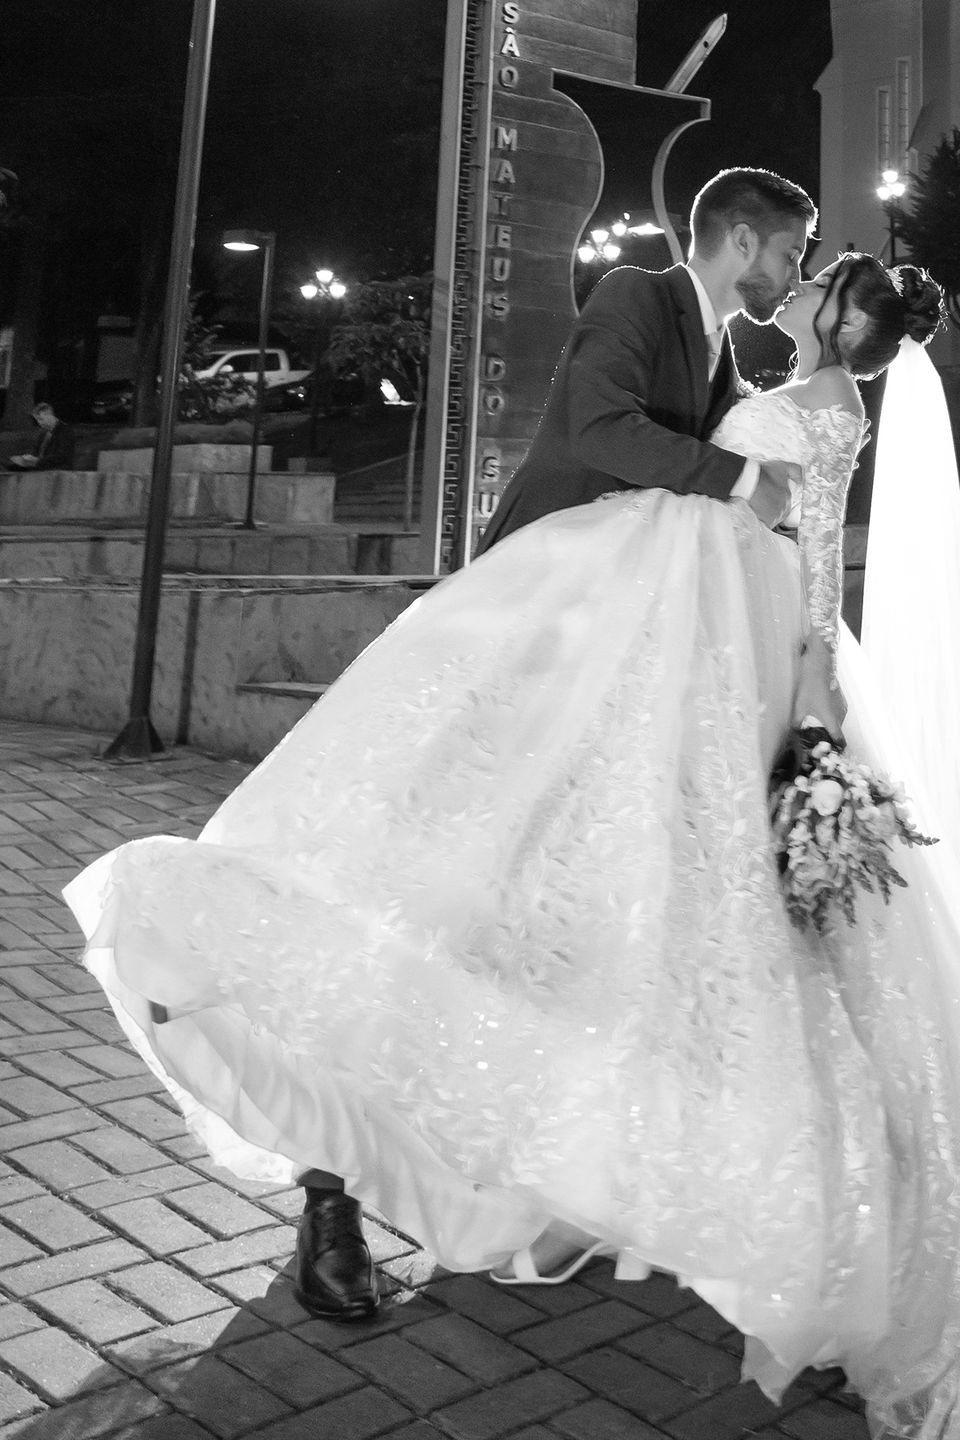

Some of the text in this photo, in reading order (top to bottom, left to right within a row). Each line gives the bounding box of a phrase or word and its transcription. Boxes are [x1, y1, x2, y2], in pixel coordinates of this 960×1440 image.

[478, 1, 520, 537] SÃO MATEUS DO SU
